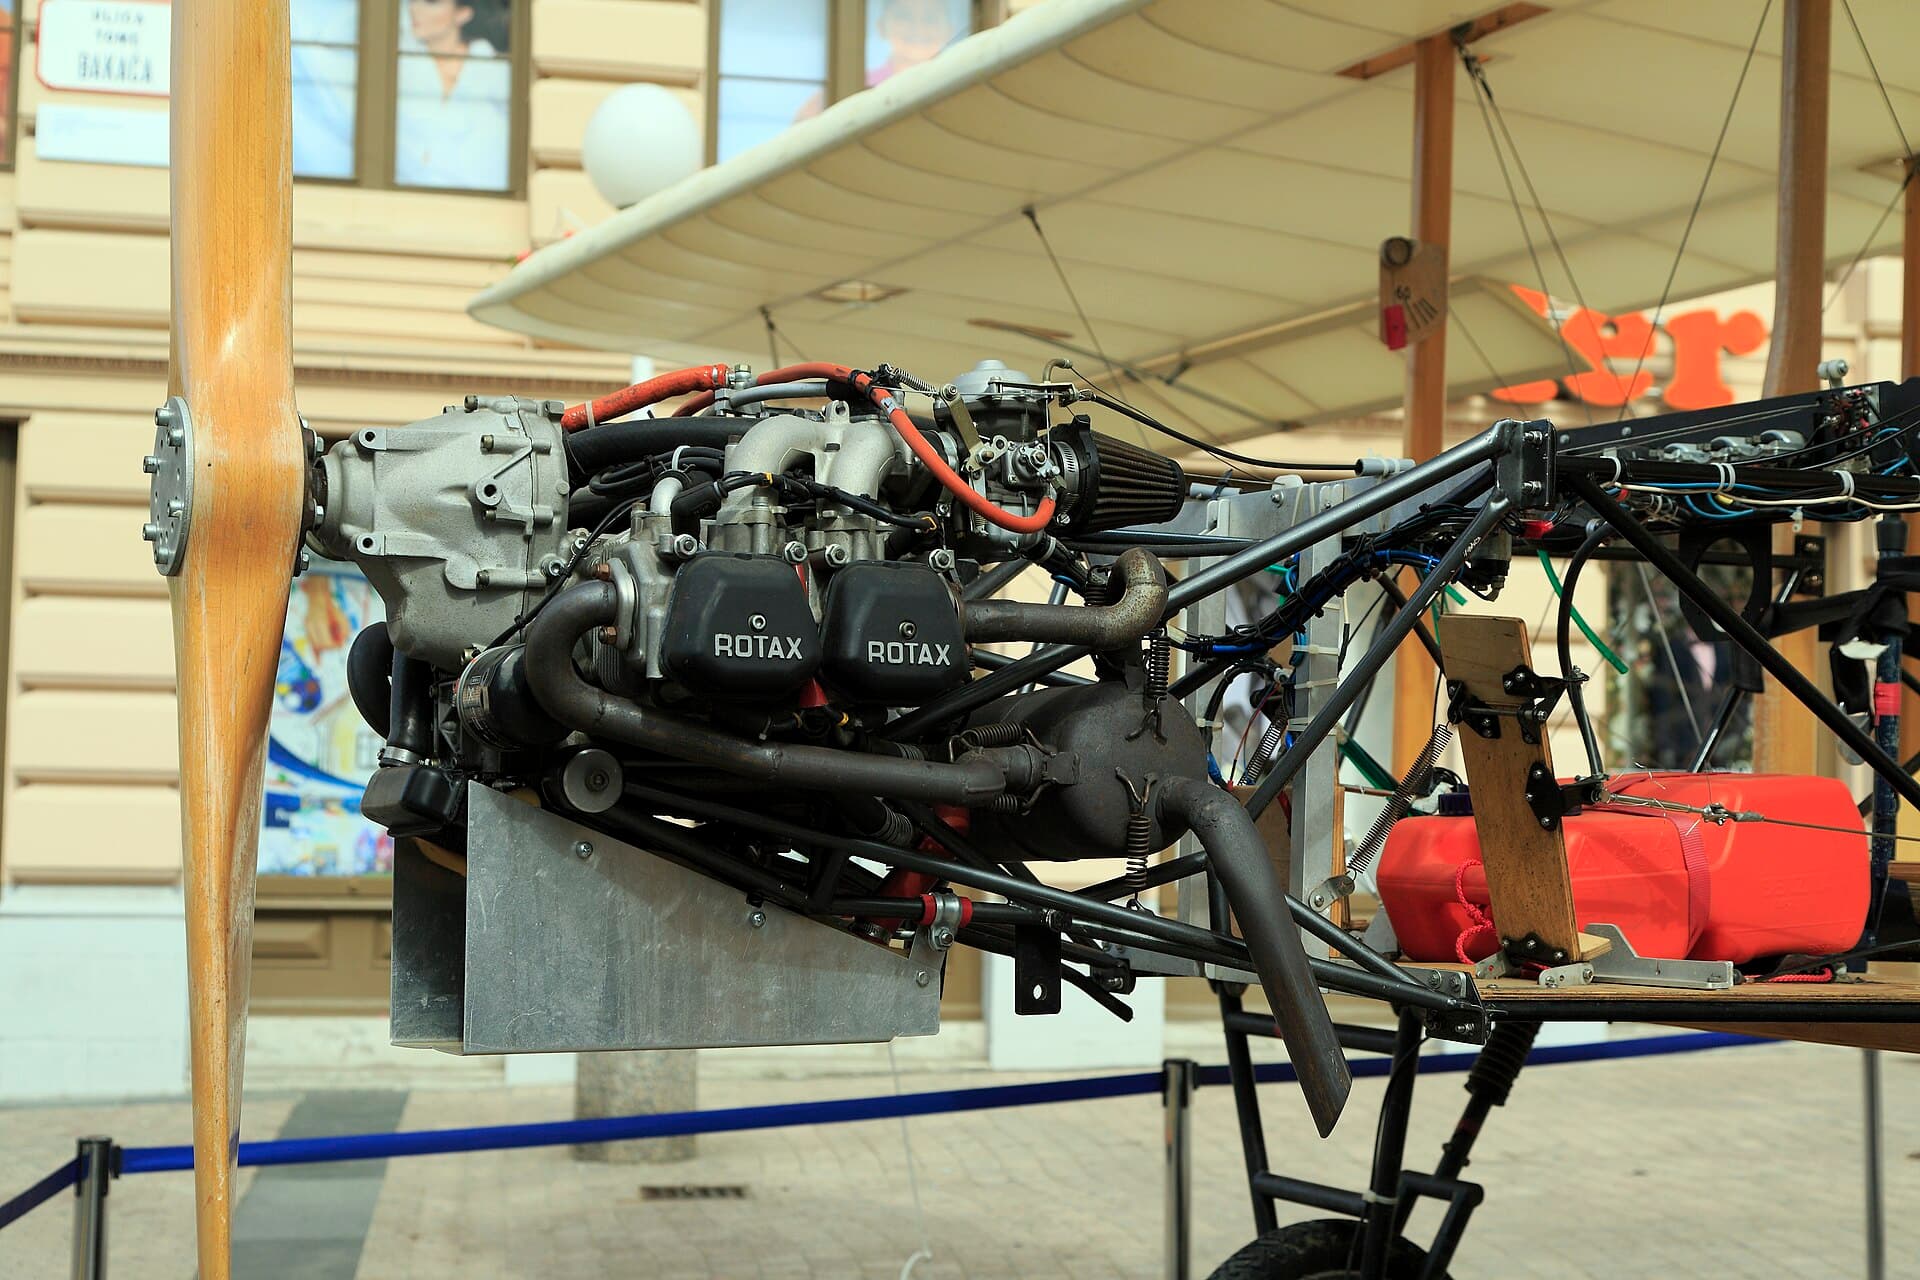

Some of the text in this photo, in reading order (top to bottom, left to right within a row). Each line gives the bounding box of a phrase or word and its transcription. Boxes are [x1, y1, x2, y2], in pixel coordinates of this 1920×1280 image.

[78, 51, 153, 82] BAKAČA
[714, 633, 803, 660] ROTAX
[867, 640, 951, 666] ROTAX
